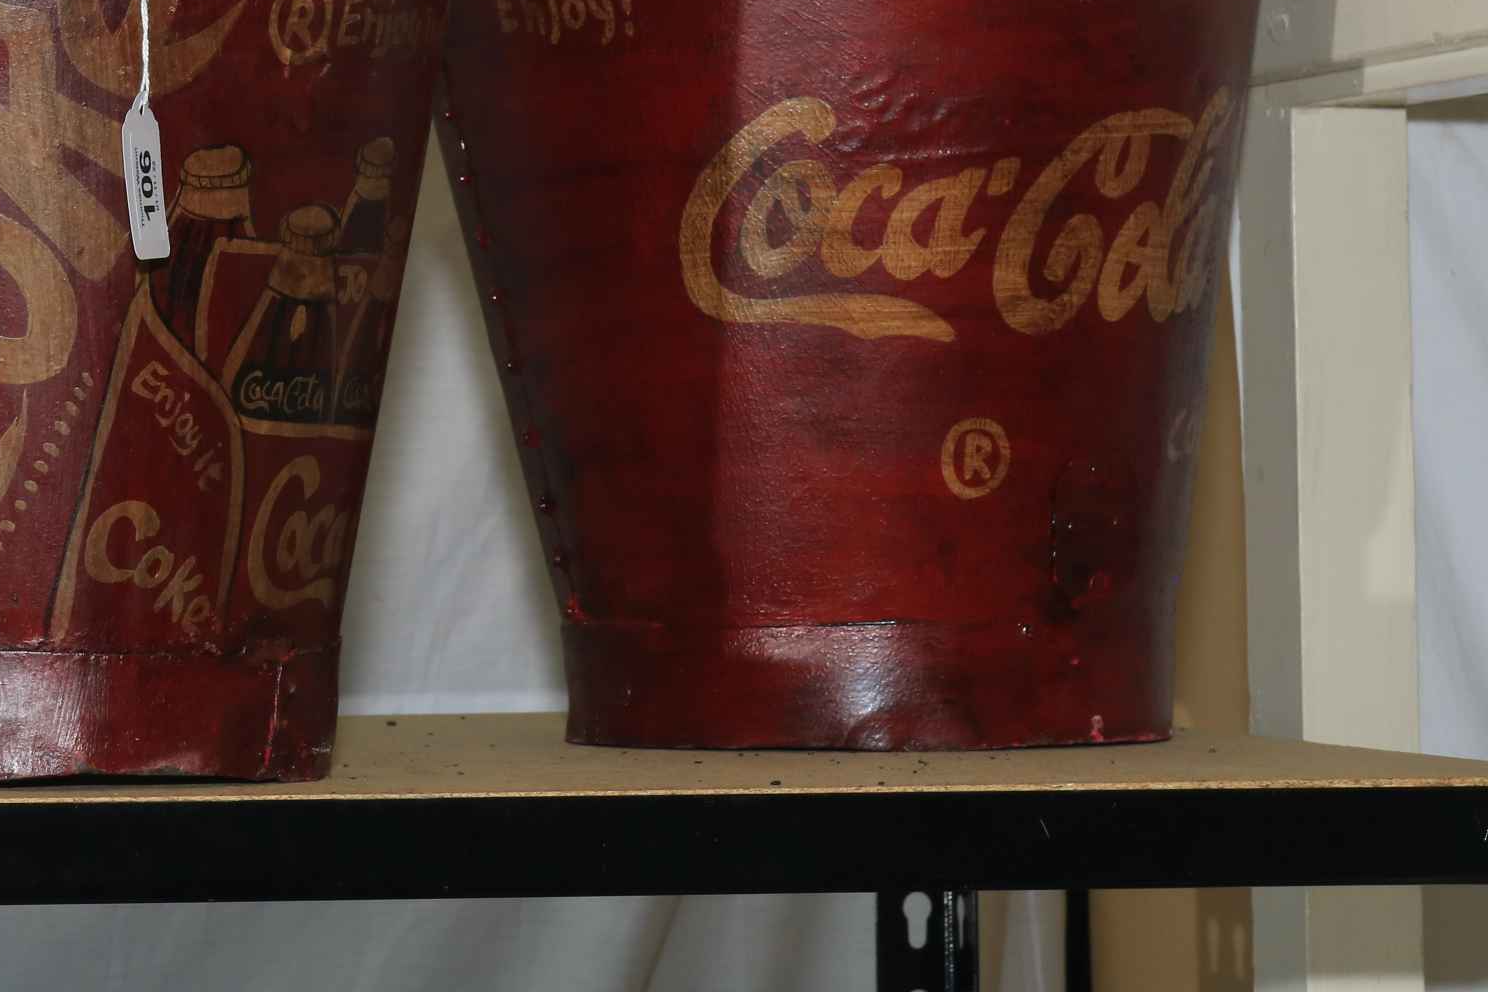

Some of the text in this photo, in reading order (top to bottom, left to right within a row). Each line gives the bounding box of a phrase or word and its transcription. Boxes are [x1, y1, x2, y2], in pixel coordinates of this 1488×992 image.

[139, 150, 156, 222] 106
[131, 359, 202, 456] Enjoy
[84, 500, 210, 630] Coke
